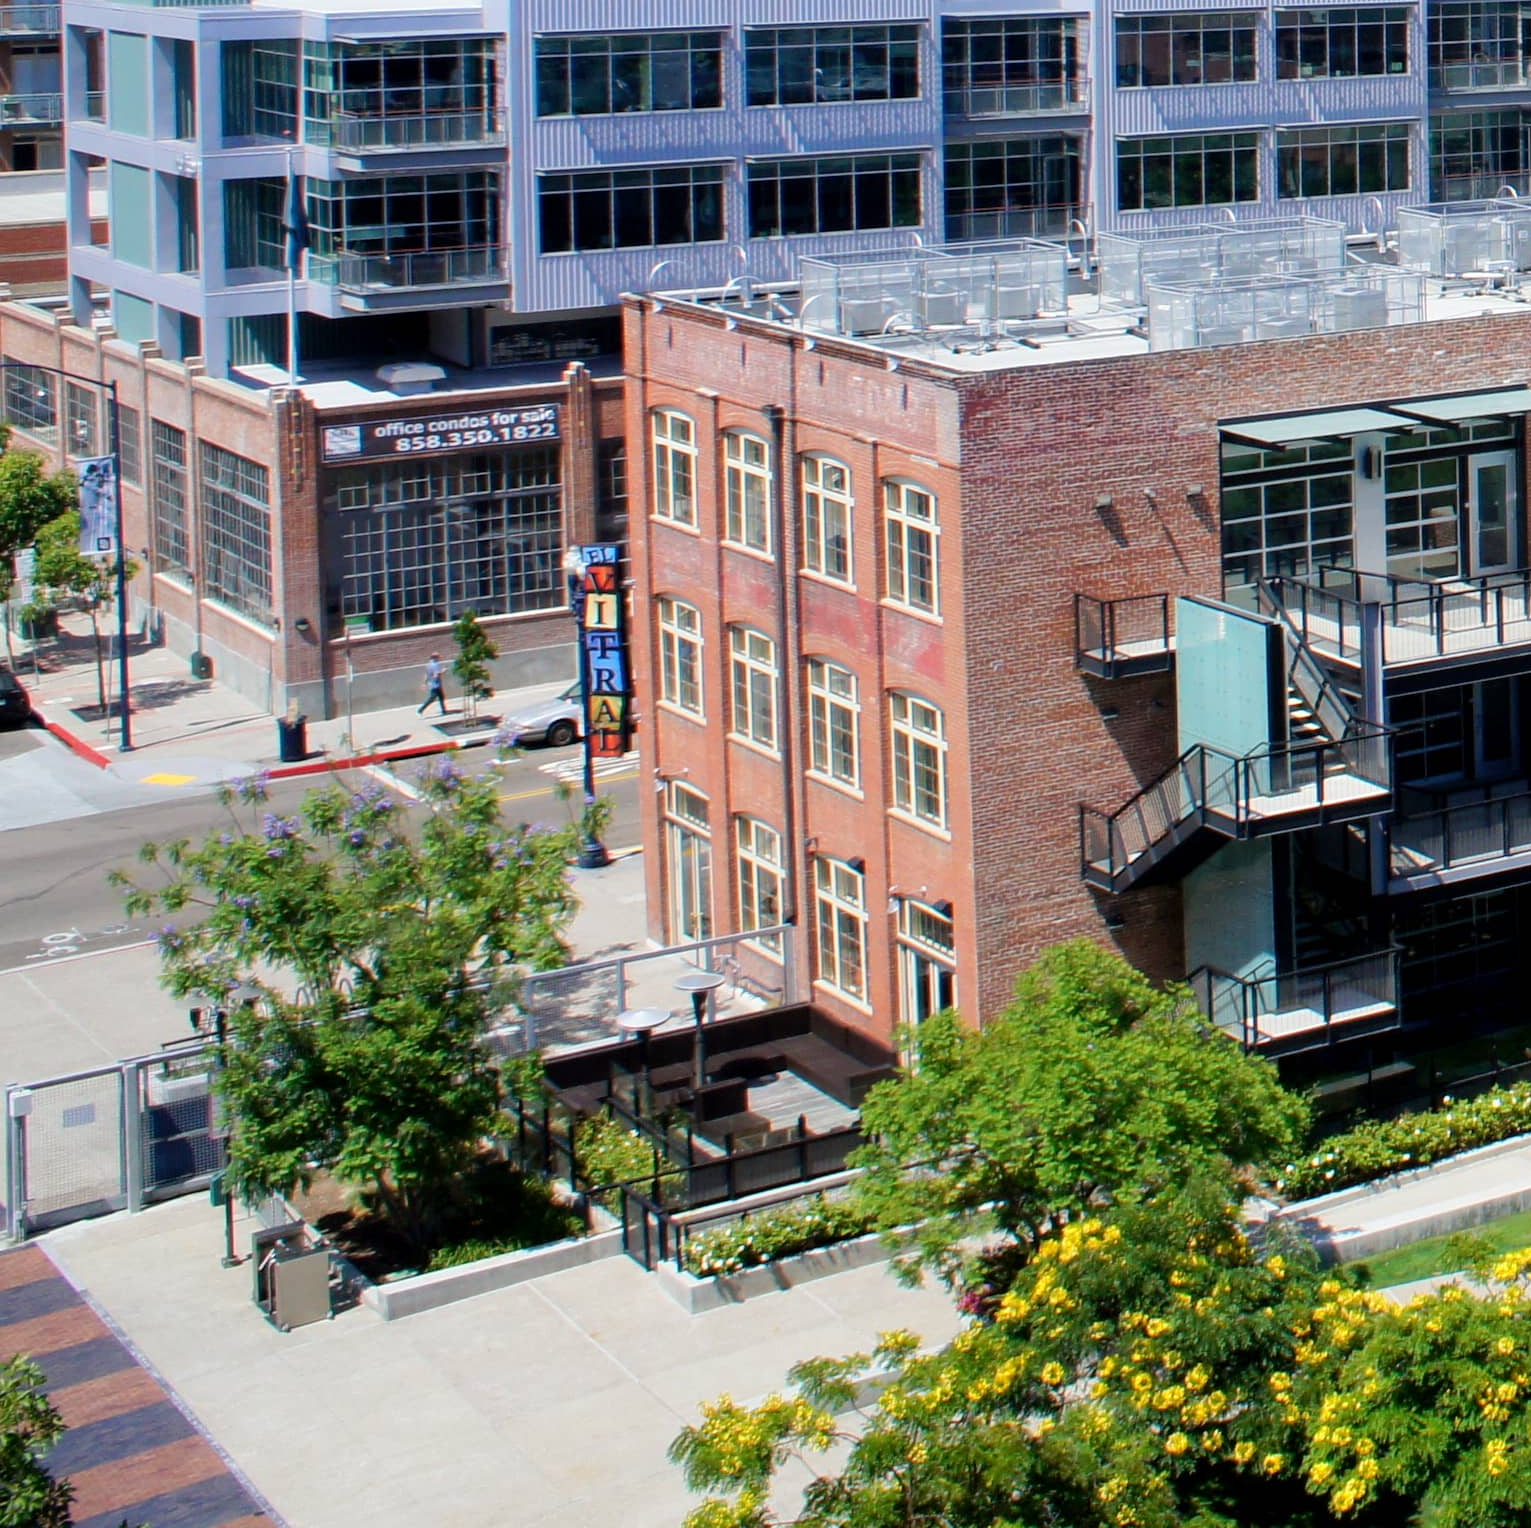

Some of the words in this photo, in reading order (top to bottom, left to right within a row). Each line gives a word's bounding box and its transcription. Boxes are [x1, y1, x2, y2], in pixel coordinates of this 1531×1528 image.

[374, 422, 424, 438] office
[428, 415, 489, 432] condos
[491, 411, 518, 426] for
[521, 407, 555, 422] sale
[396, 423, 556, 452] 858.350.1822
[588, 550, 614, 564] EL
[587, 571, 622, 752] VITRAL
